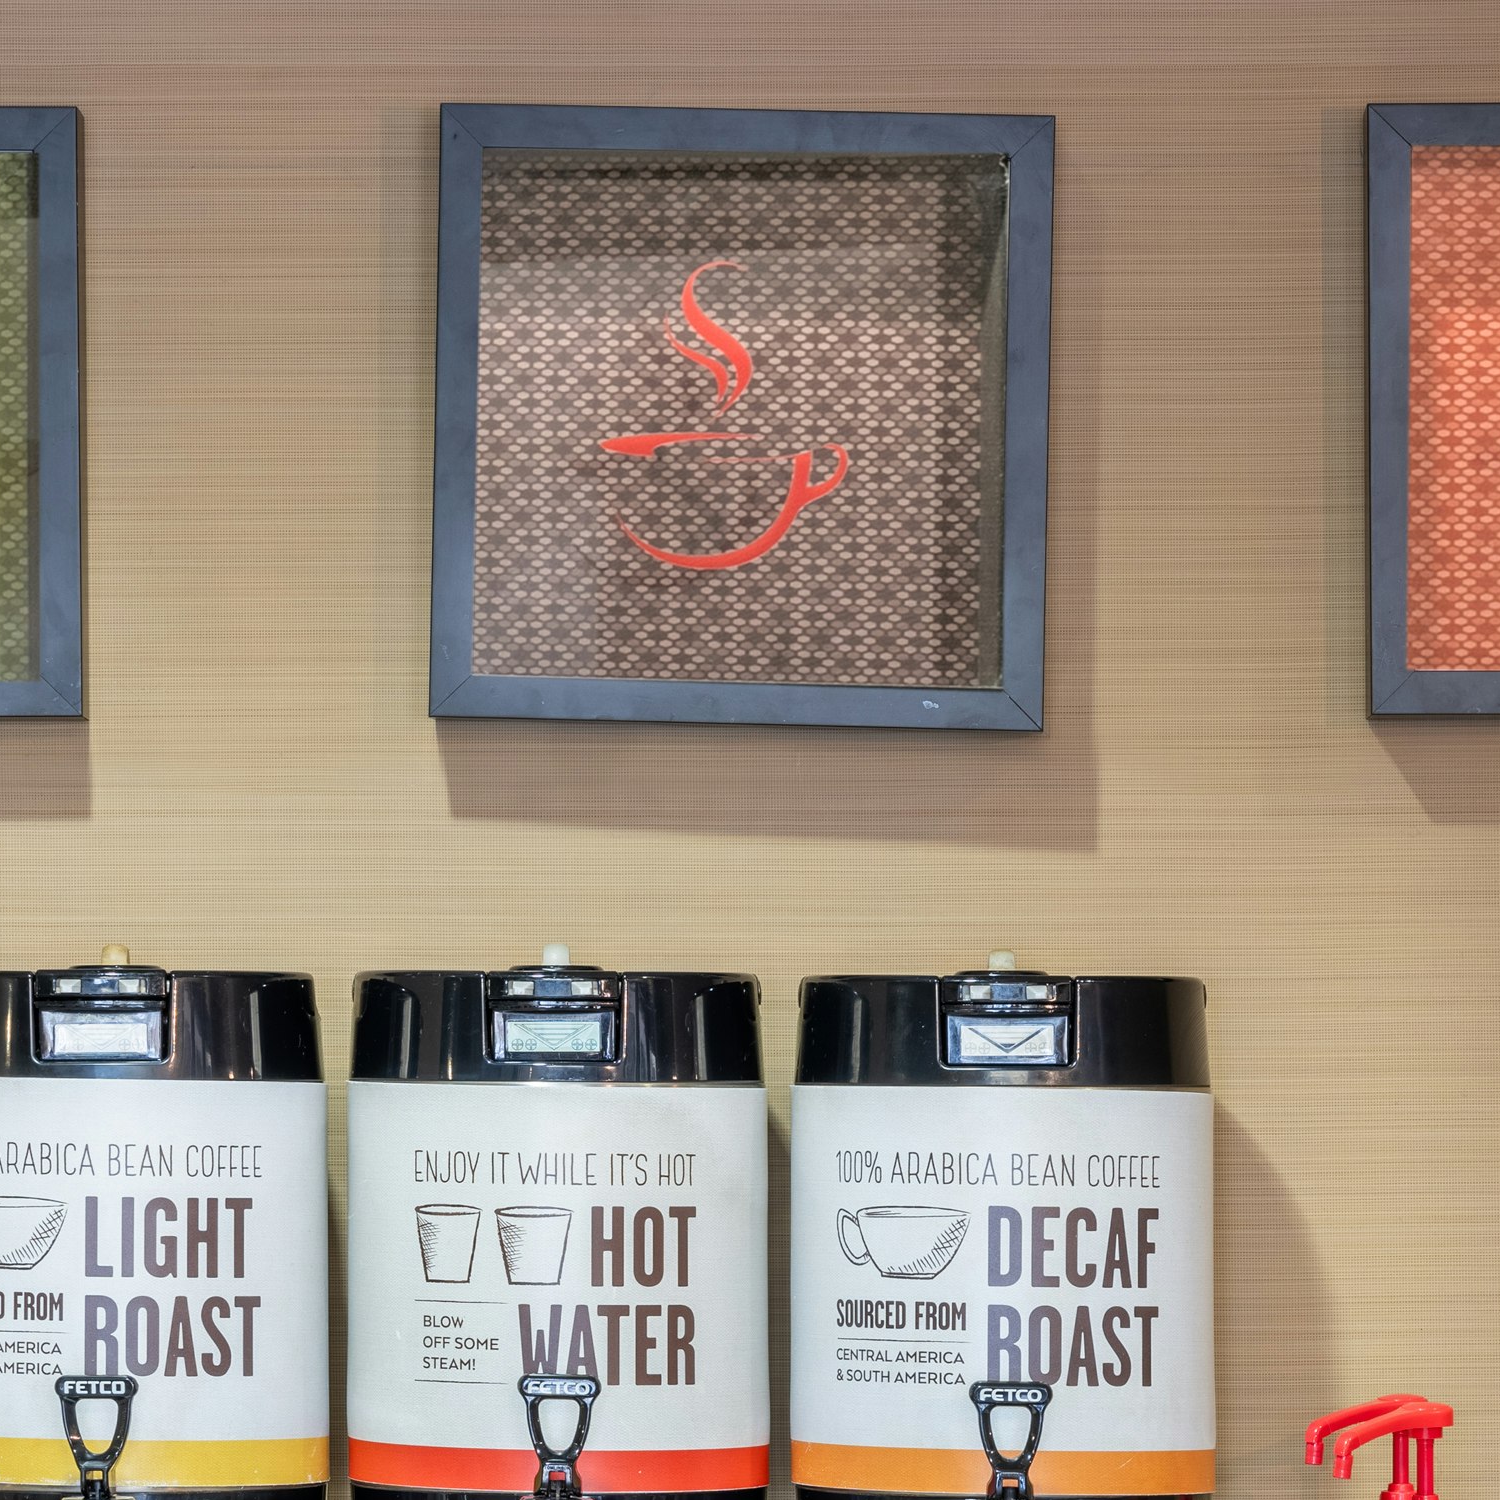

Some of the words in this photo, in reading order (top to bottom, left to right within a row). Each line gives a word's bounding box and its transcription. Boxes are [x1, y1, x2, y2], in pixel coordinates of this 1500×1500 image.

[108, 1144, 174, 1177] BEAN
[186, 1145, 263, 1178] COFFEE
[414, 1150, 480, 1184] ENJOY
[491, 1151, 510, 1185] IT
[518, 1152, 597, 1186] WHILE
[610, 1153, 649, 1186] IT'S
[658, 1154, 696, 1186] HOT
[836, 1150, 882, 1184] 100%
[891, 1151, 998, 1186] ARABICA
[1011, 1153, 1076, 1187] BEAN
[1088, 1154, 1161, 1188] COFFEE
[85, 1196, 253, 1279] LIGHT
[591, 1205, 697, 1288] HOT
[987, 1205, 1159, 1289] DECAF
[13, 1291, 64, 1322] FROM
[423, 1315, 464, 1329] BLOW
[836, 1298, 906, 1330] SOURCED
[914, 1301, 967, 1332] FROM
[84, 1294, 261, 1378] ROAST
[422, 1336, 450, 1349] OFF
[454, 1337, 499, 1351] SOME
[518, 1303, 696, 1386] WATER
[987, 1304, 1159, 1388] ROAST
[422, 1356, 476, 1371] STEAM!
[836, 1347, 892, 1363] CENTRAL
[895, 1350, 966, 1366] AMERICA
[63, 1380, 126, 1395] FETCO
[526, 1380, 591, 1395] FETCO
[836, 1369, 844, 1382] &
[846, 1370, 891, 1384] SOUTH
[893, 1371, 967, 1386] AMERICA
[979, 1388, 1043, 1403] FETCO
